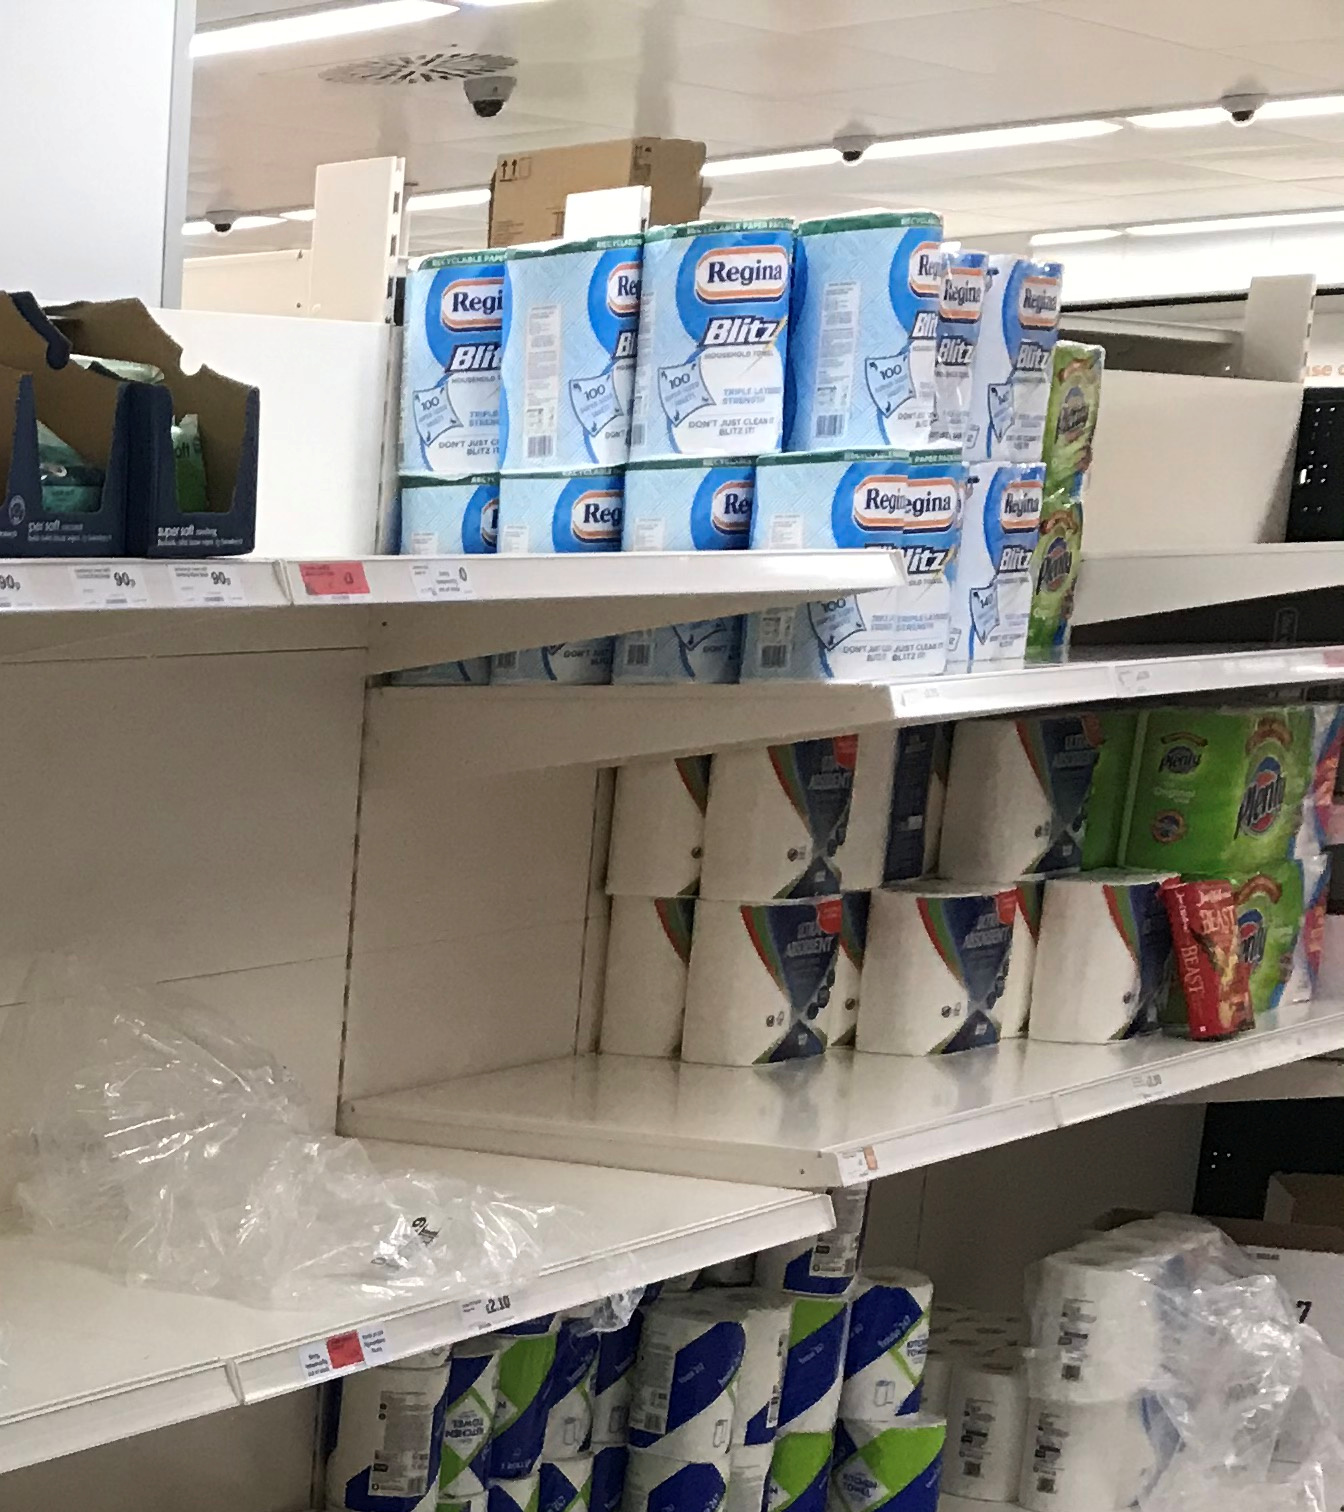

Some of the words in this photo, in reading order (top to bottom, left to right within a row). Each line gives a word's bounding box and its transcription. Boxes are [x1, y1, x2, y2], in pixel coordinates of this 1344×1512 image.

[707, 259, 782, 286] Regina
[919, 254, 941, 279] Reg
[452, 289, 503, 316] Regi
[944, 278, 981, 305] Regina
[703, 317, 779, 345] Blitz
[938, 338, 974, 364] Blitz
[669, 373, 691, 388] 100
[880, 363, 903, 379] 100
[421, 396, 440, 410] 100
[584, 384, 606, 399] 100
[583, 503, 623, 526] Reg
[114, 572, 136, 588] 90p
[211, 571, 232, 585] 90p
[1202, 908, 1235, 934] BEAST
[1180, 943, 1205, 994] BEAST
[1296, 1300, 1312, 1324] 7
